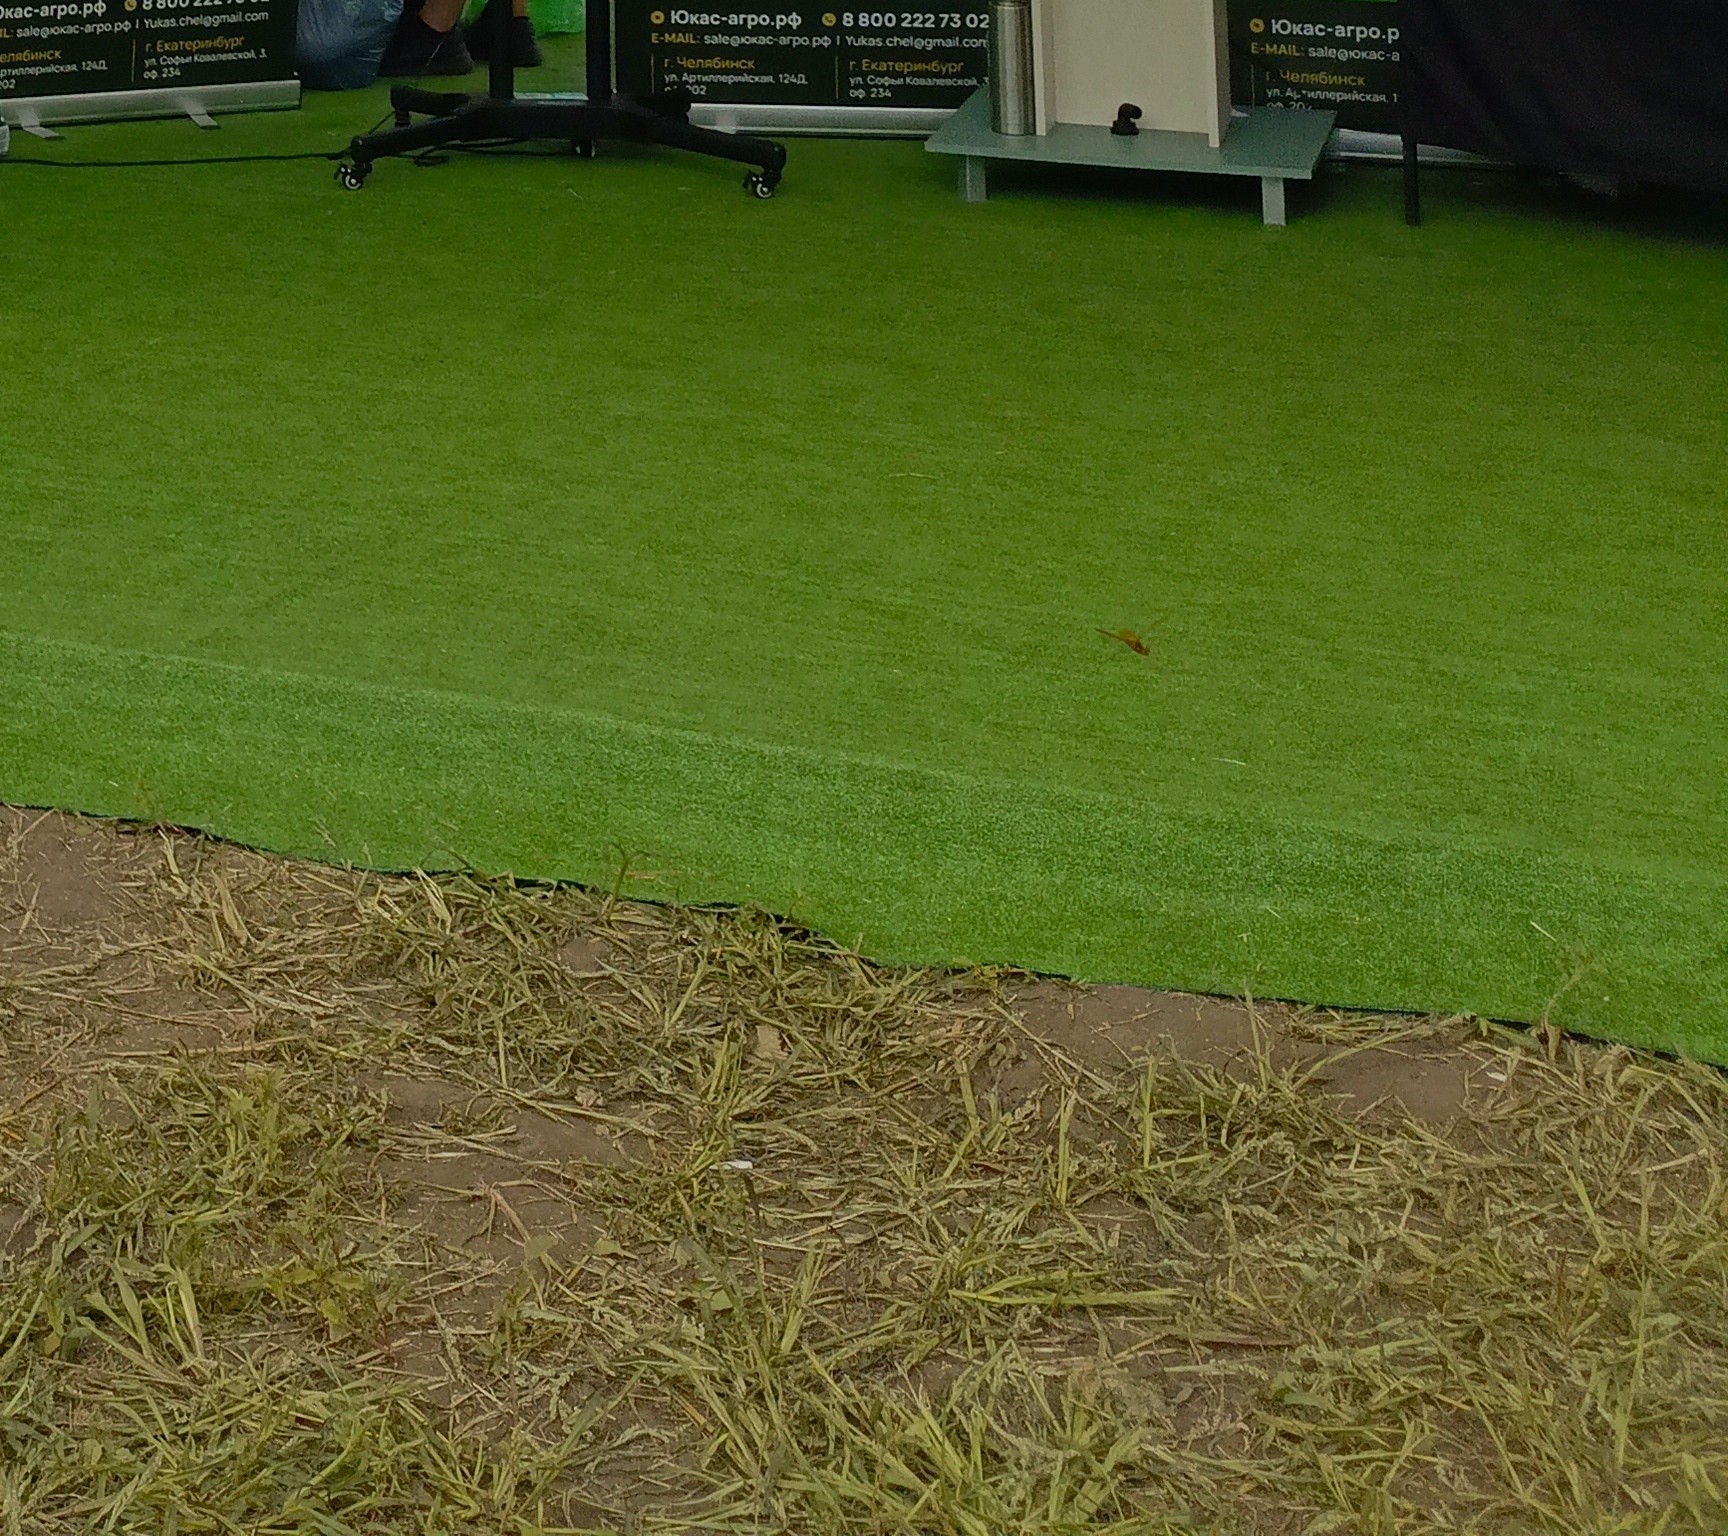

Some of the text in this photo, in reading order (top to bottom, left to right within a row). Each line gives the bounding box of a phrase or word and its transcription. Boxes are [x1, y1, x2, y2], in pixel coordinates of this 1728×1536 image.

[144, 11, 269, 29] Yukas.chel@gmail.com
[671, 10, 802, 29] Юкас-агро.рф
[842, 12, 990, 28] 8 800 222 73 02
[156, 37, 245, 53] Екатеринбург
[651, 33, 701, 44] E-MAIL:
[1251, 43, 1304, 57] E-MAIL:
[160, 55, 192, 66] Софьи
[677, 57, 755, 69] Челябинск
[862, 59, 964, 74] Екатеринбург
[162, 67, 180, 78] 234
[1280, 70, 1366, 86] Челябинск
[867, 76, 904, 86] Софьи
[870, 88, 892, 98] 234
